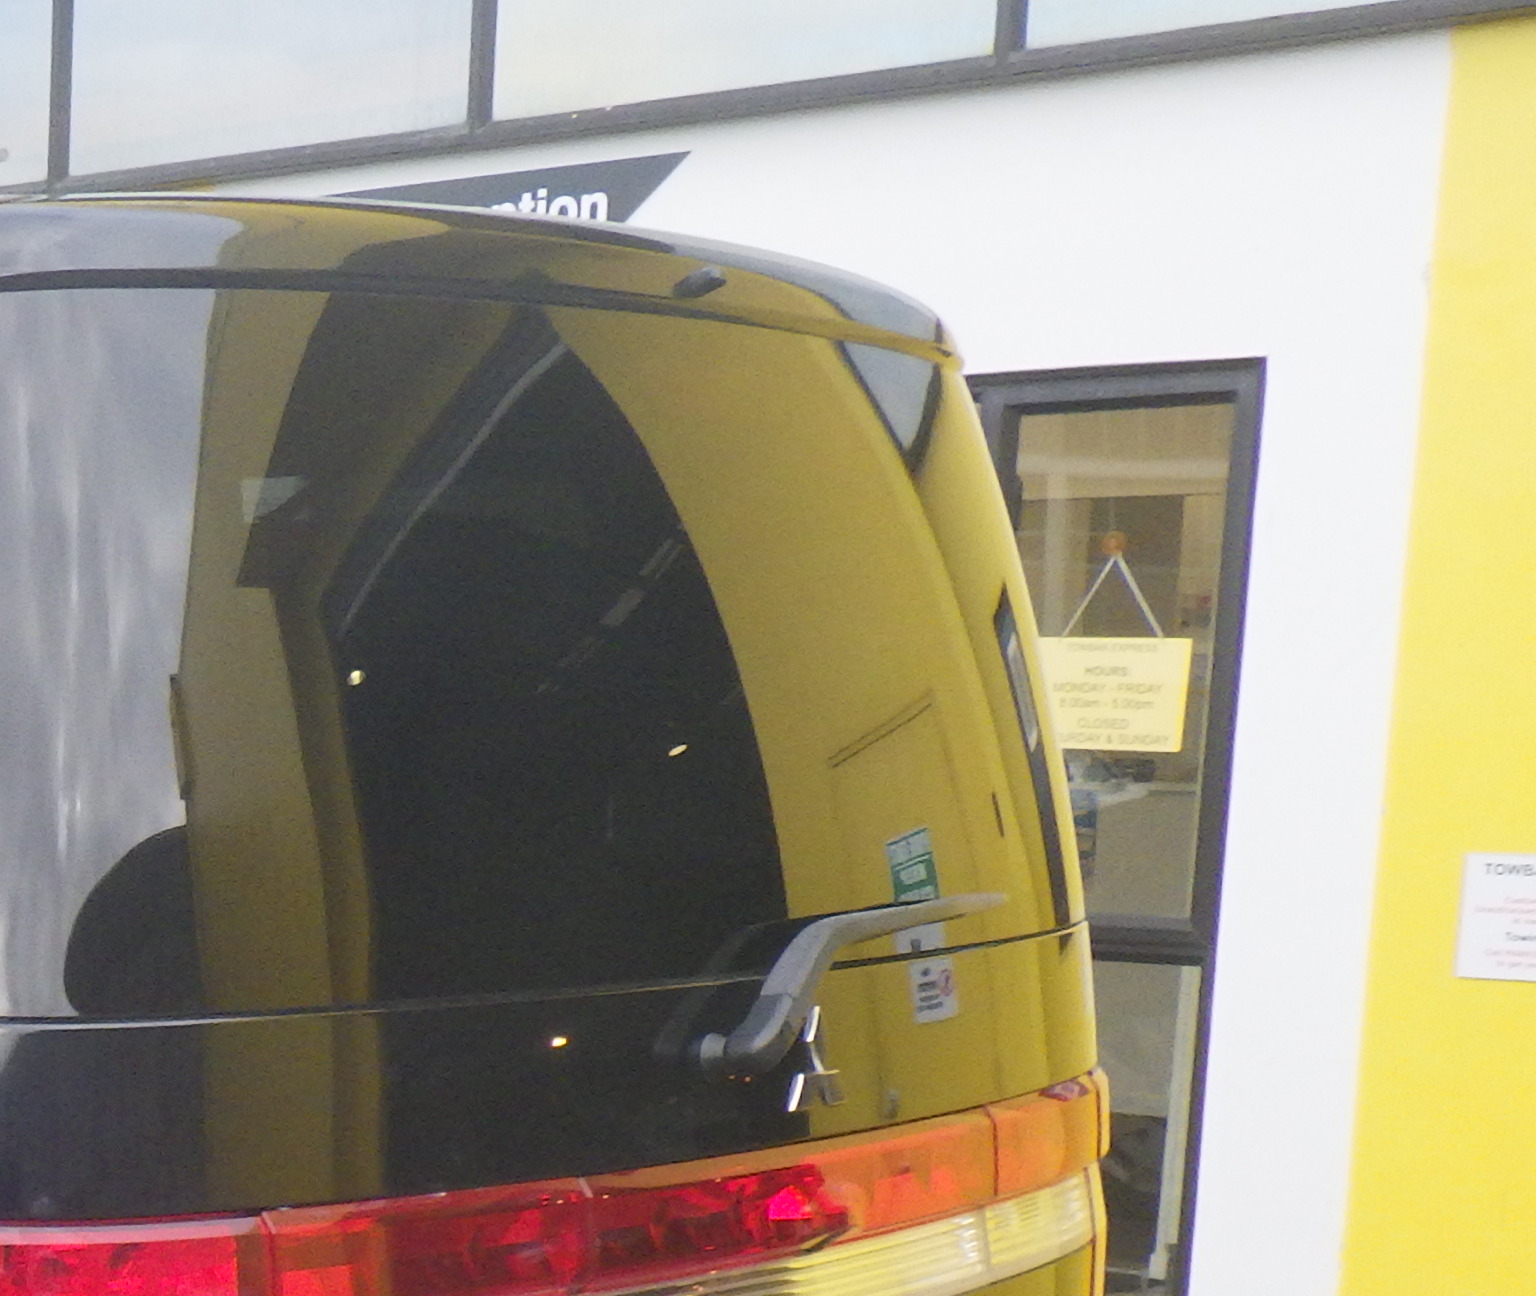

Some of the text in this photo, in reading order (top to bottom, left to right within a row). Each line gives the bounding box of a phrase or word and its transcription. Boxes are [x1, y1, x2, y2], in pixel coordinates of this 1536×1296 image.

[490, 187, 608, 222] tion
[1053, 682, 1106, 693] MONDAY
[1117, 683, 1163, 694] FRIDAY
[1076, 717, 1130, 730] CLOSED
[1118, 733, 1169, 746] SUNDAY
